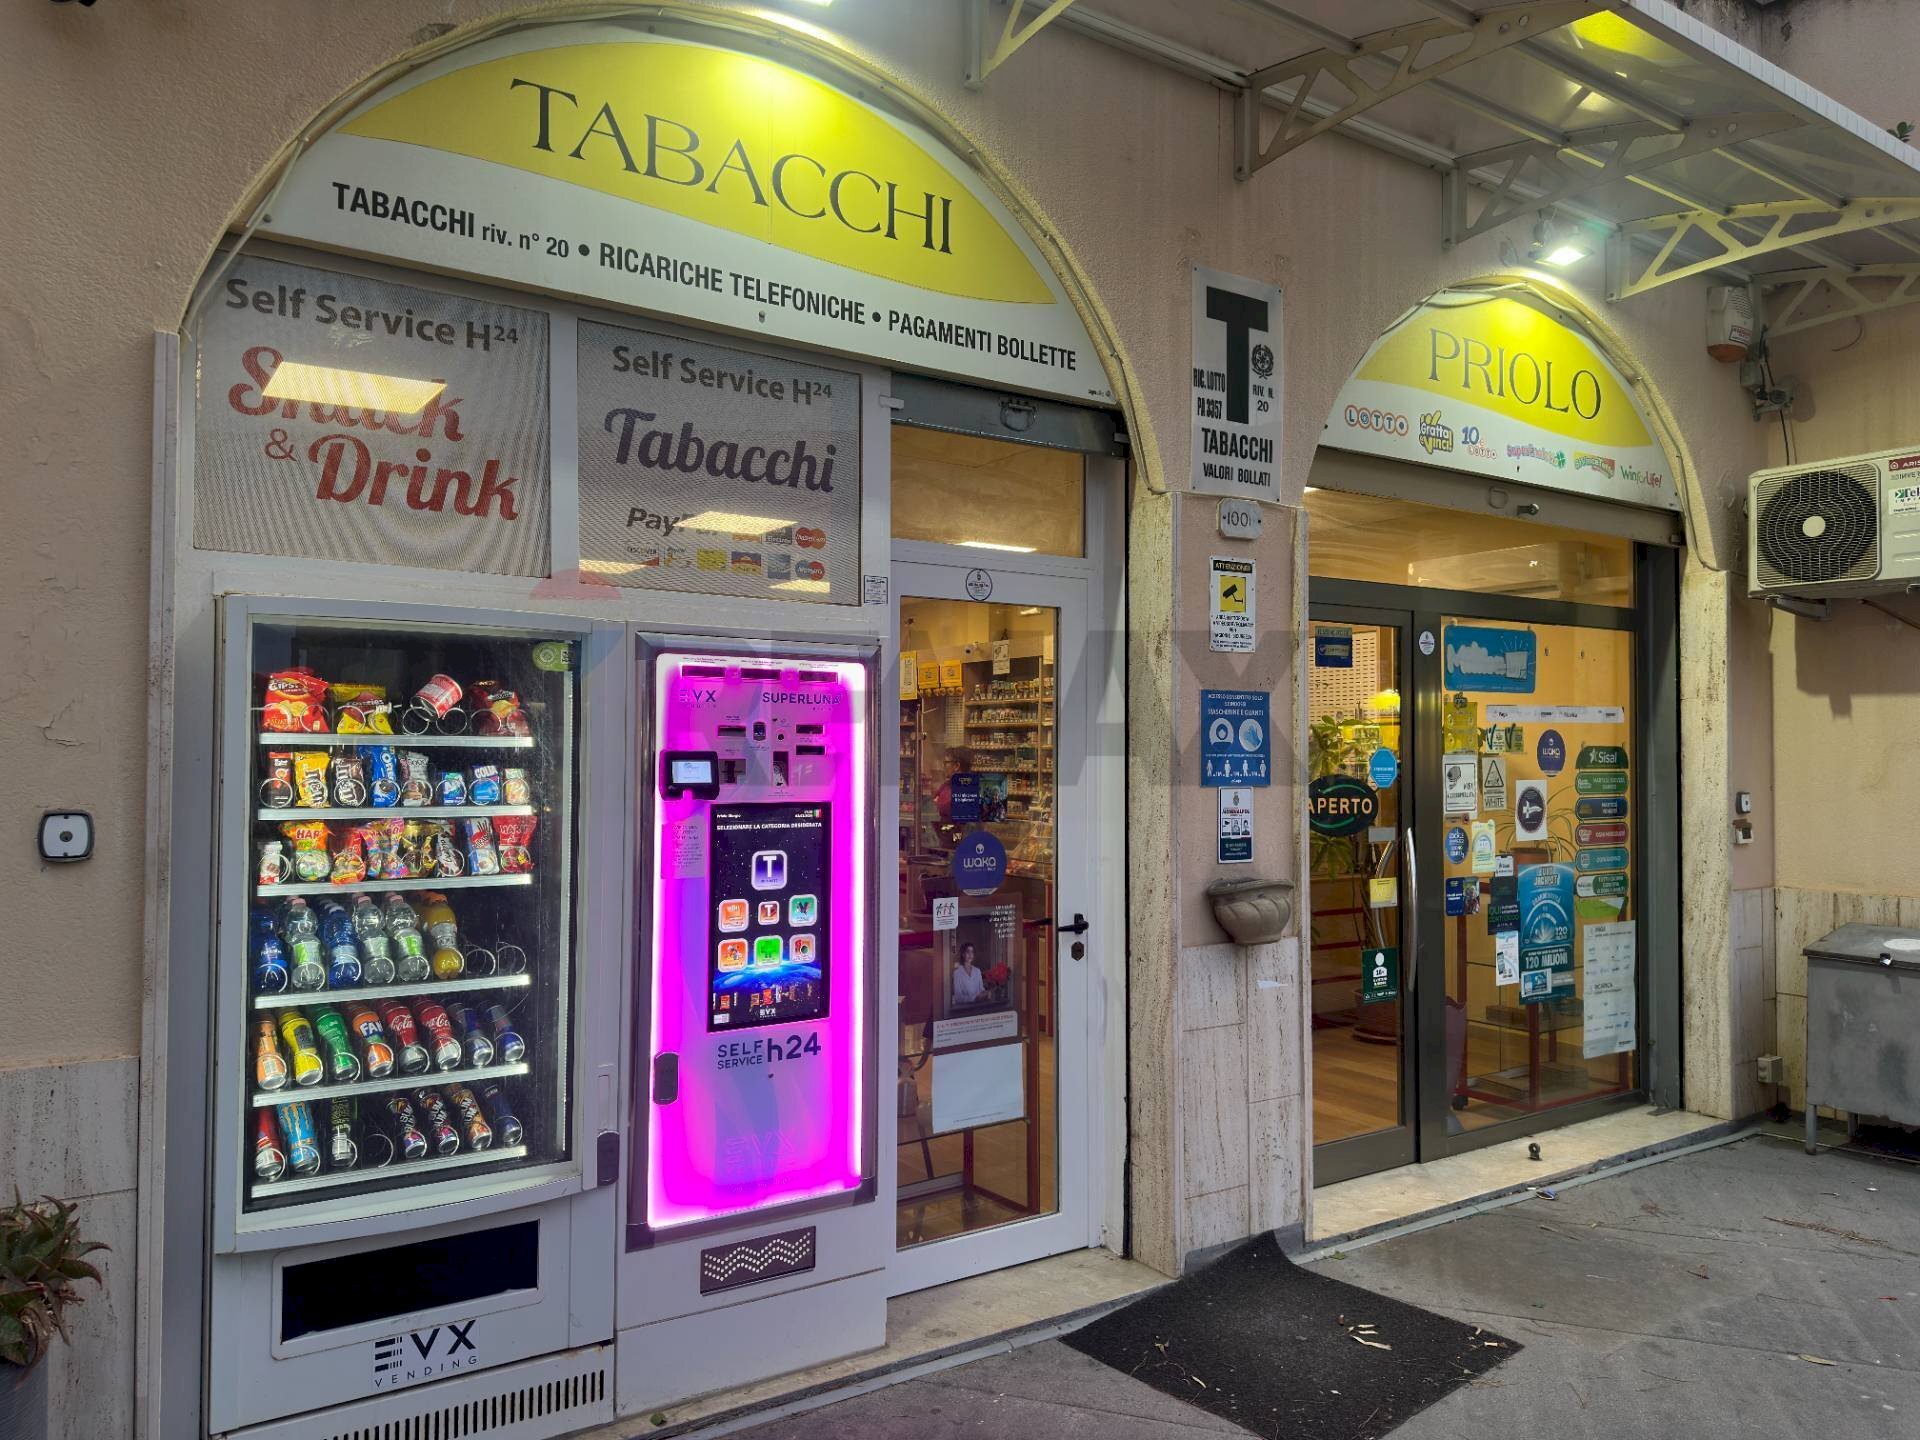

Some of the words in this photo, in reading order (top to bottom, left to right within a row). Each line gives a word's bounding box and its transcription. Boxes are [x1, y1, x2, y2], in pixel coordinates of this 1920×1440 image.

[511, 78, 953, 255] TABACCHI
[332, 182, 475, 238] TABACCHI
[482, 221, 513, 247] riv.
[546, 237, 570, 258] 20
[599, 242, 723, 294] RICARICHE
[729, 270, 866, 326] TELEFONICHE
[888, 309, 992, 354] PAGAMENTI
[997, 334, 1077, 372] BOLLETTE
[225, 278, 307, 319] Self
[315, 293, 456, 345] Service
[1206, 284, 1269, 425] T
[612, 345, 674, 380] Self
[680, 357, 785, 401] Service
[1206, 370, 1226, 393] LOTTO
[1428, 327, 1602, 420] PRIOLO
[1256, 400, 1270, 413] 20
[1344, 404, 1409, 437] LOTTO
[1201, 427, 1274, 464] TABACCHI
[1420, 422, 1449, 440] Gratta
[1461, 426, 1480, 445] 10
[604, 407, 838, 493] Tabacchi
[265, 428, 298, 462] &
[307, 433, 519, 521] Drink
[1202, 462, 1234, 481] VALORI
[1237, 468, 1272, 488] BOLLATI
[1598, 751, 1617, 764] Sisal
[1307, 797, 1373, 815] APERTO
[1525, 957, 1540, 969] 120
[717, 1039, 764, 1058] SELF
[767, 1031, 822, 1063] h24
[717, 1054, 763, 1070] SERVICE
[374, 1319, 477, 1373] EVX
[374, 1355, 478, 1388] VENDING
